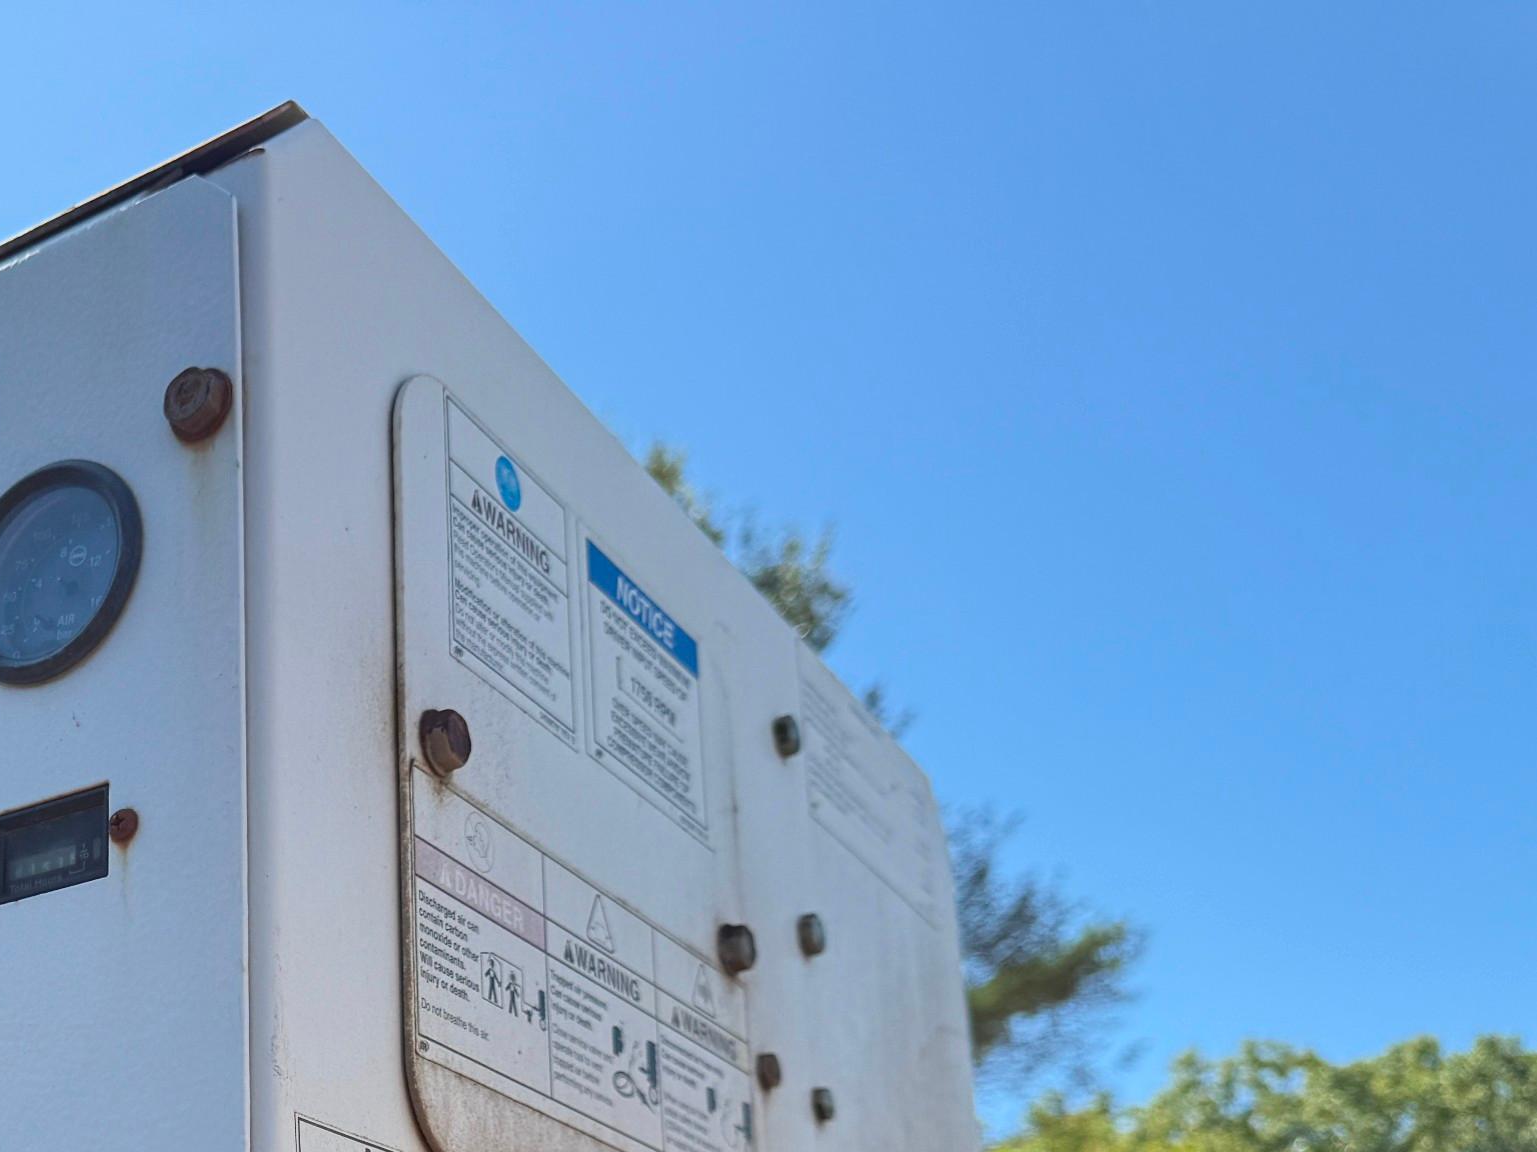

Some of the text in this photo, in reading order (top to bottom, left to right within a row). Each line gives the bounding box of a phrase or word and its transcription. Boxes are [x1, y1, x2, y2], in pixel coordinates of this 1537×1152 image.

[483, 498, 550, 573] WARNING
[57, 613, 75, 627] AIR
[617, 578, 673, 646] NOTICE
[418, 889, 455, 920] Discharged
[454, 870, 523, 930] DANGER
[418, 907, 468, 941] contain carbon
[419, 922, 452, 947] monoxide
[419, 950, 479, 992] Will cause serious
[419, 966, 439, 988] injury
[575, 945, 640, 1001] WARNING
[420, 996, 430, 1012] Do
